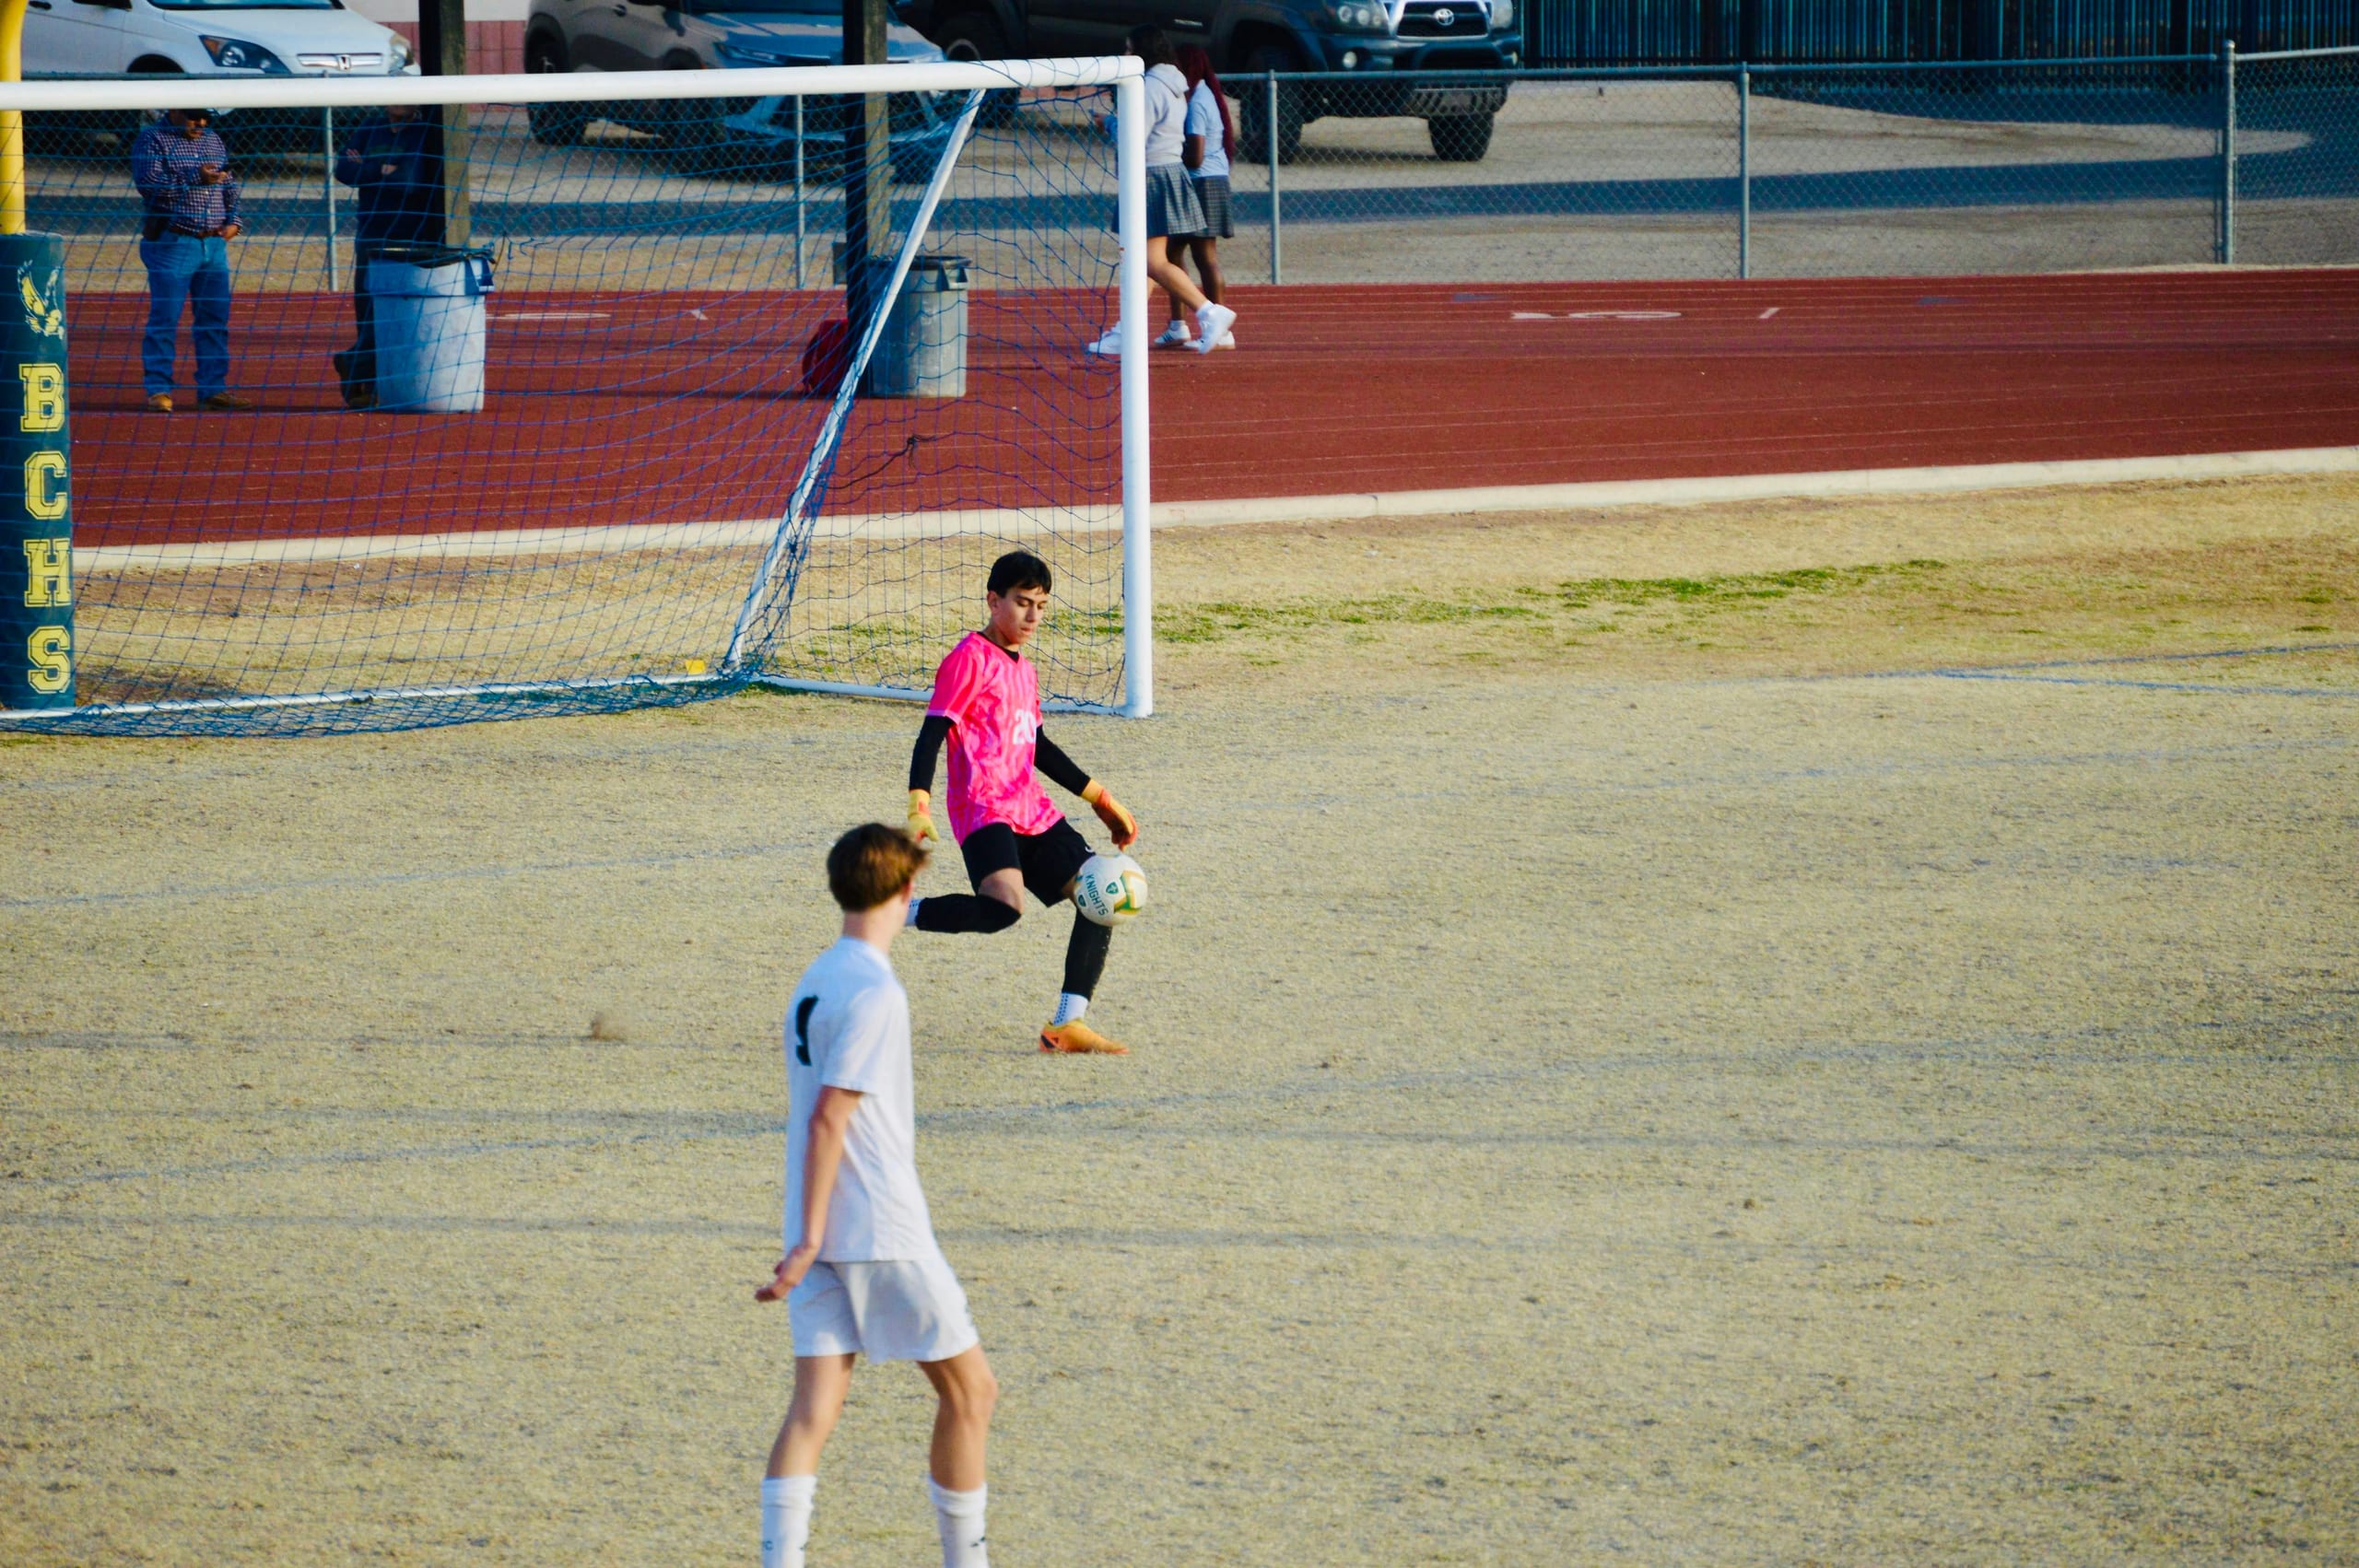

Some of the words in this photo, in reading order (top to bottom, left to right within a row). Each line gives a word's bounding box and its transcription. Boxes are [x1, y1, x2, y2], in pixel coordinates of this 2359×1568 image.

[18, 363, 71, 694] BCHS
[1013, 709, 1037, 744] 20
[1086, 873, 1109, 916] KNIGHTS
